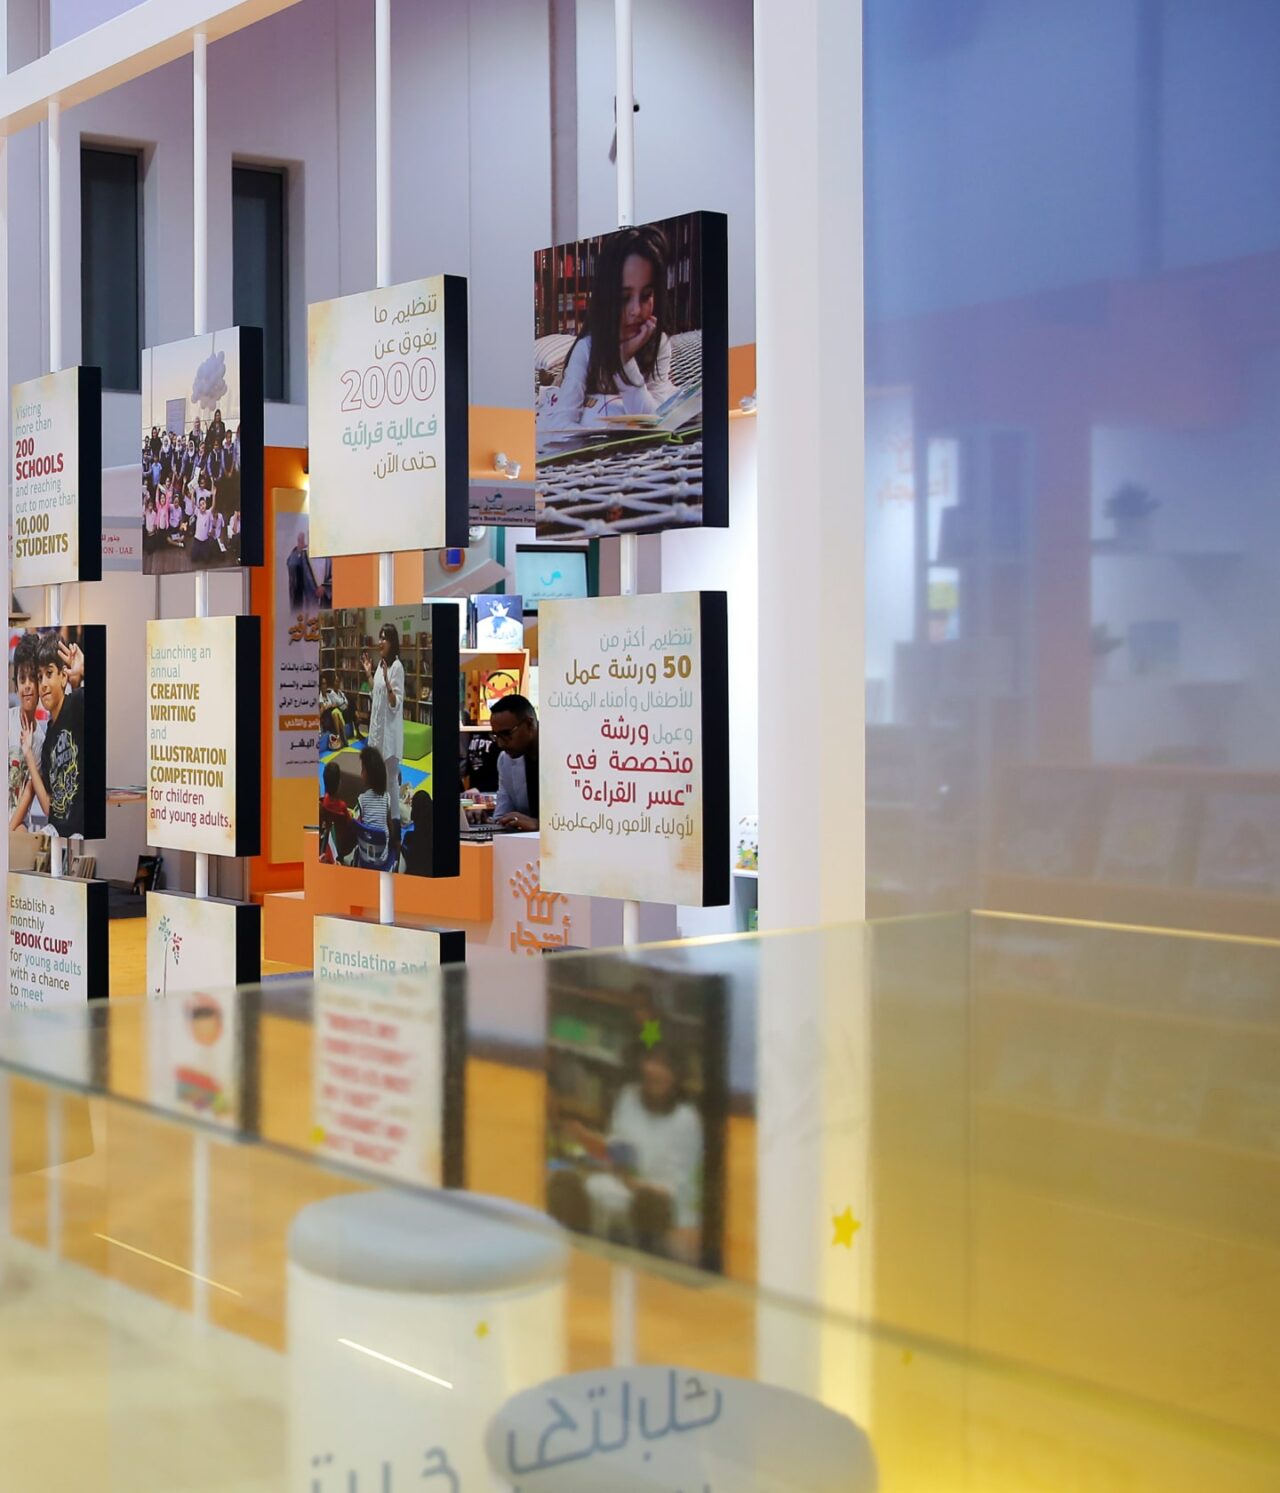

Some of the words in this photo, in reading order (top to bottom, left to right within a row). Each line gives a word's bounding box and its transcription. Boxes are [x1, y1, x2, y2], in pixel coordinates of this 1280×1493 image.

[374, 305, 388, 323] ما
[391, 294, 437, 325] تنظيم
[375, 339, 395, 360] عن
[398, 328, 437, 356] يفوق
[341, 357, 436, 412] 2000
[16, 403, 41, 419] Visiting
[16, 422, 34, 436] more
[35, 417, 52, 431] than
[342, 421, 383, 451] قرائية
[387, 415, 437, 446] فعالية
[16, 438, 34, 458] 200
[16, 453, 64, 481] SCHOOLS
[402, 451, 437, 472] حتى
[16, 483, 28, 497] and
[30, 479, 62, 495] reaching
[16, 499, 28, 513] out
[29, 498, 36, 511] to
[38, 496, 57, 511] more
[59, 493, 76, 507] than
[16, 513, 49, 538] 10,000
[16, 533, 68, 558] STUDENTS
[600, 633, 620, 653] من
[622, 625, 645, 652] أكثر
[649, 628, 692, 651] تنظيم
[150, 644, 197, 662] Launching
[200, 647, 211, 659] an
[150, 665, 181, 678] annual
[566, 659, 600, 686] عمل
[608, 655, 657, 685] ورشة
[663, 655, 692, 679] 50
[150, 683, 200, 700] CREATIVE
[548, 690, 596, 712] المكتبات
[641, 688, 693, 712] للأطفال
[150, 705, 196, 722] WRITING
[150, 726, 167, 740] and
[601, 715, 649, 745] ورشة
[652, 723, 693, 746] وعمل
[150, 745, 227, 765] ILLUSTRATION
[567, 749, 597, 776] في
[609, 751, 693, 774] متخصصة
[150, 766, 224, 788] COMPETITION
[150, 787, 163, 801] for
[165, 788, 205, 805] children
[150, 807, 167, 821] and
[169, 811, 197, 828] young
[200, 811, 232, 829] adults.
[616, 812, 652, 836] الأمور
[655, 815, 693, 840] لأولياء
[10, 895, 47, 914] Establish
[49, 905, 55, 915] a
[10, 914, 45, 933] monthly
[10, 948, 22, 962] for
[24, 953, 51, 972] young
[54, 959, 82, 976] adults
[320, 945, 396, 976] Translating
[401, 961, 428, 976] and
[10, 966, 28, 981] with
[31, 972, 36, 983] a
[38, 972, 70, 991] chance
[10, 983, 19, 996] to
[21, 987, 44, 1002] meet
